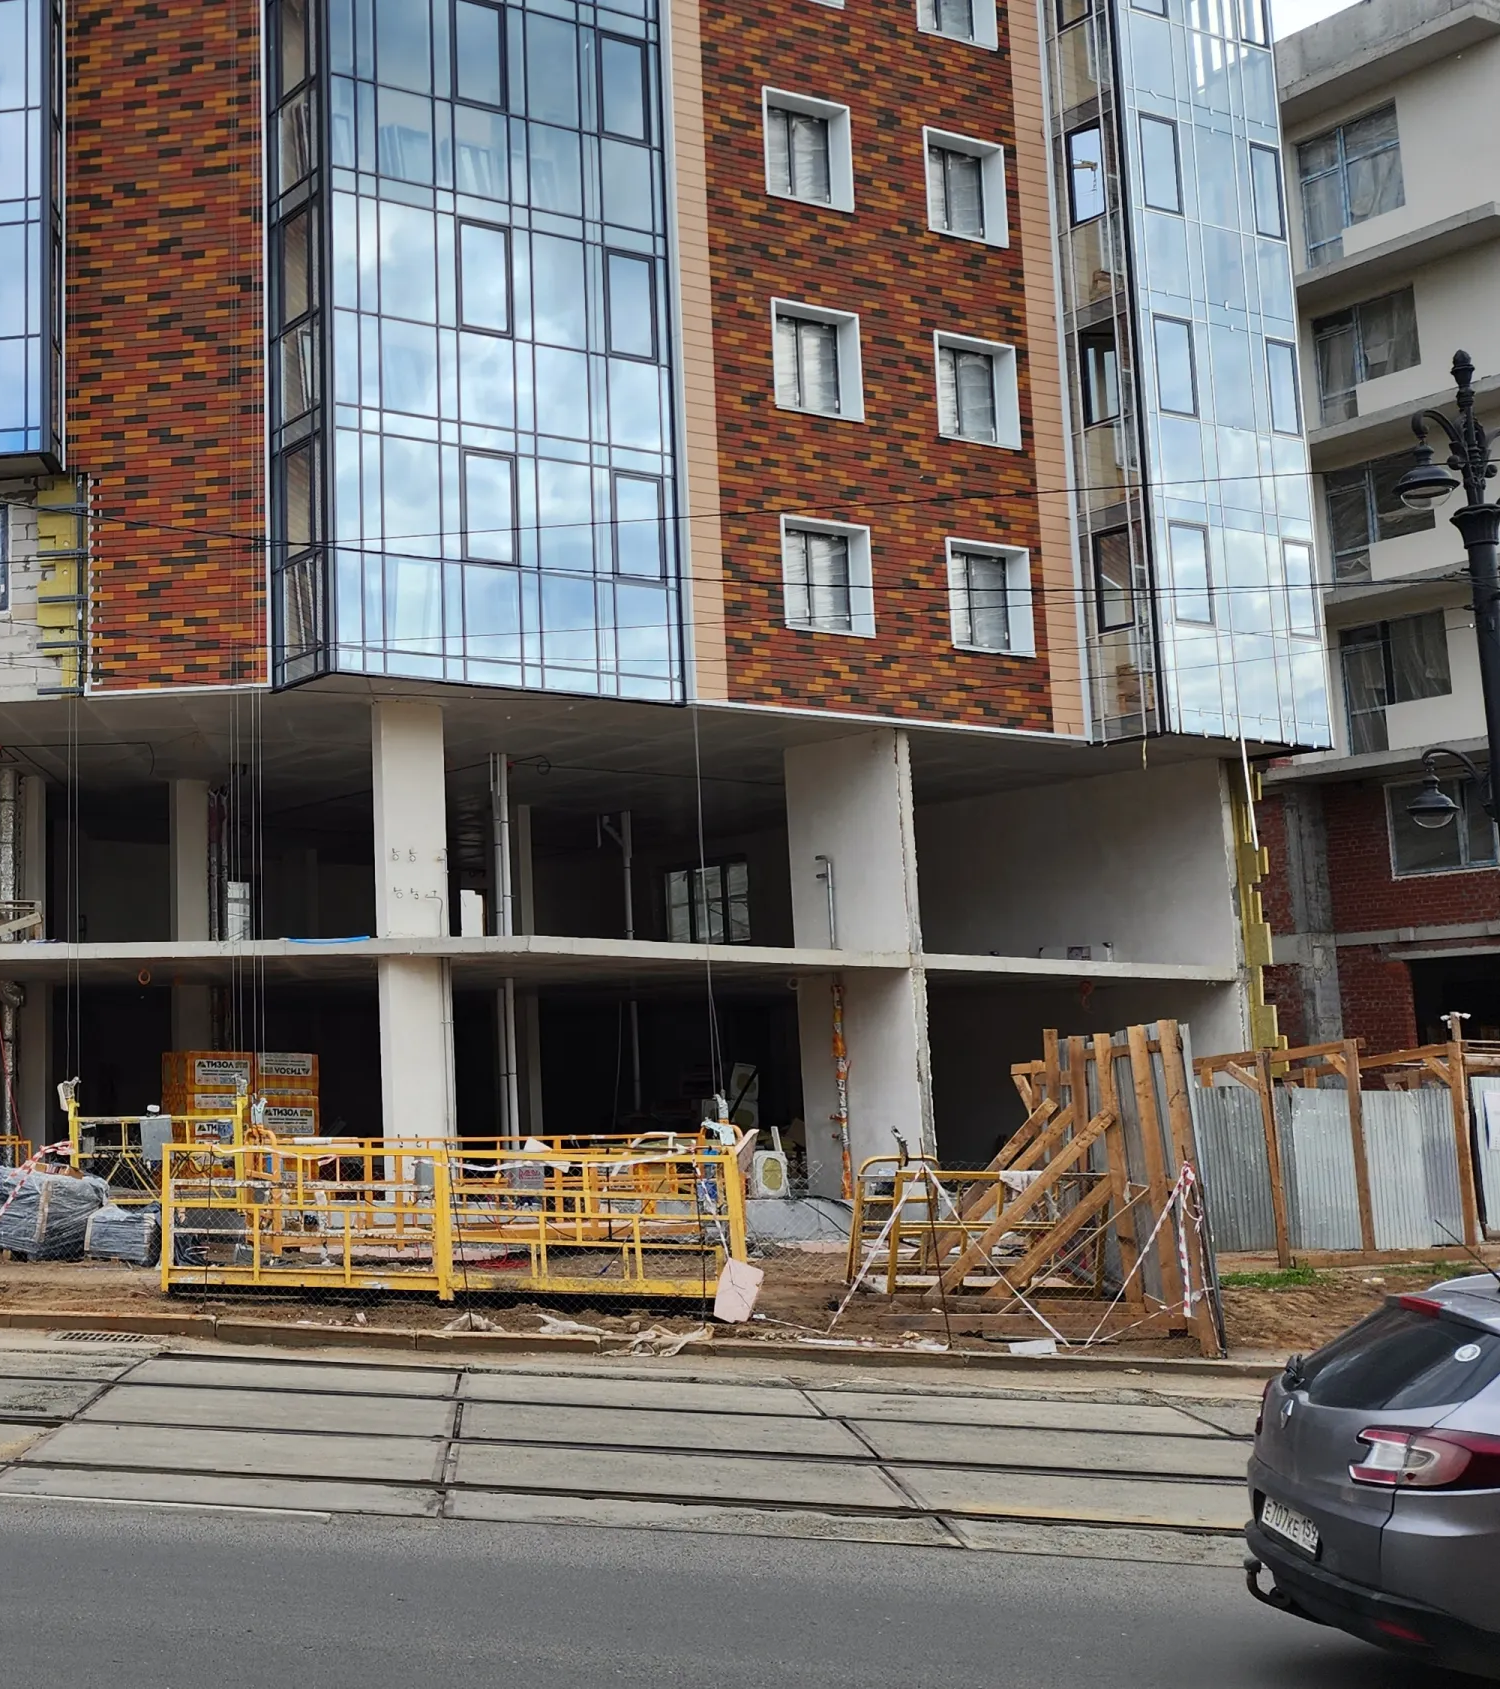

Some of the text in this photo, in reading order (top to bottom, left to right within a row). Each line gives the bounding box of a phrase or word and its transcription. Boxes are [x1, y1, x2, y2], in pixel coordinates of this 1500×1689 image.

[206, 1061, 234, 1069] ТИЗОЛ
[274, 1066, 302, 1075] ТИЗОЛ
[273, 1108, 299, 1117] ТИЗОЛ
